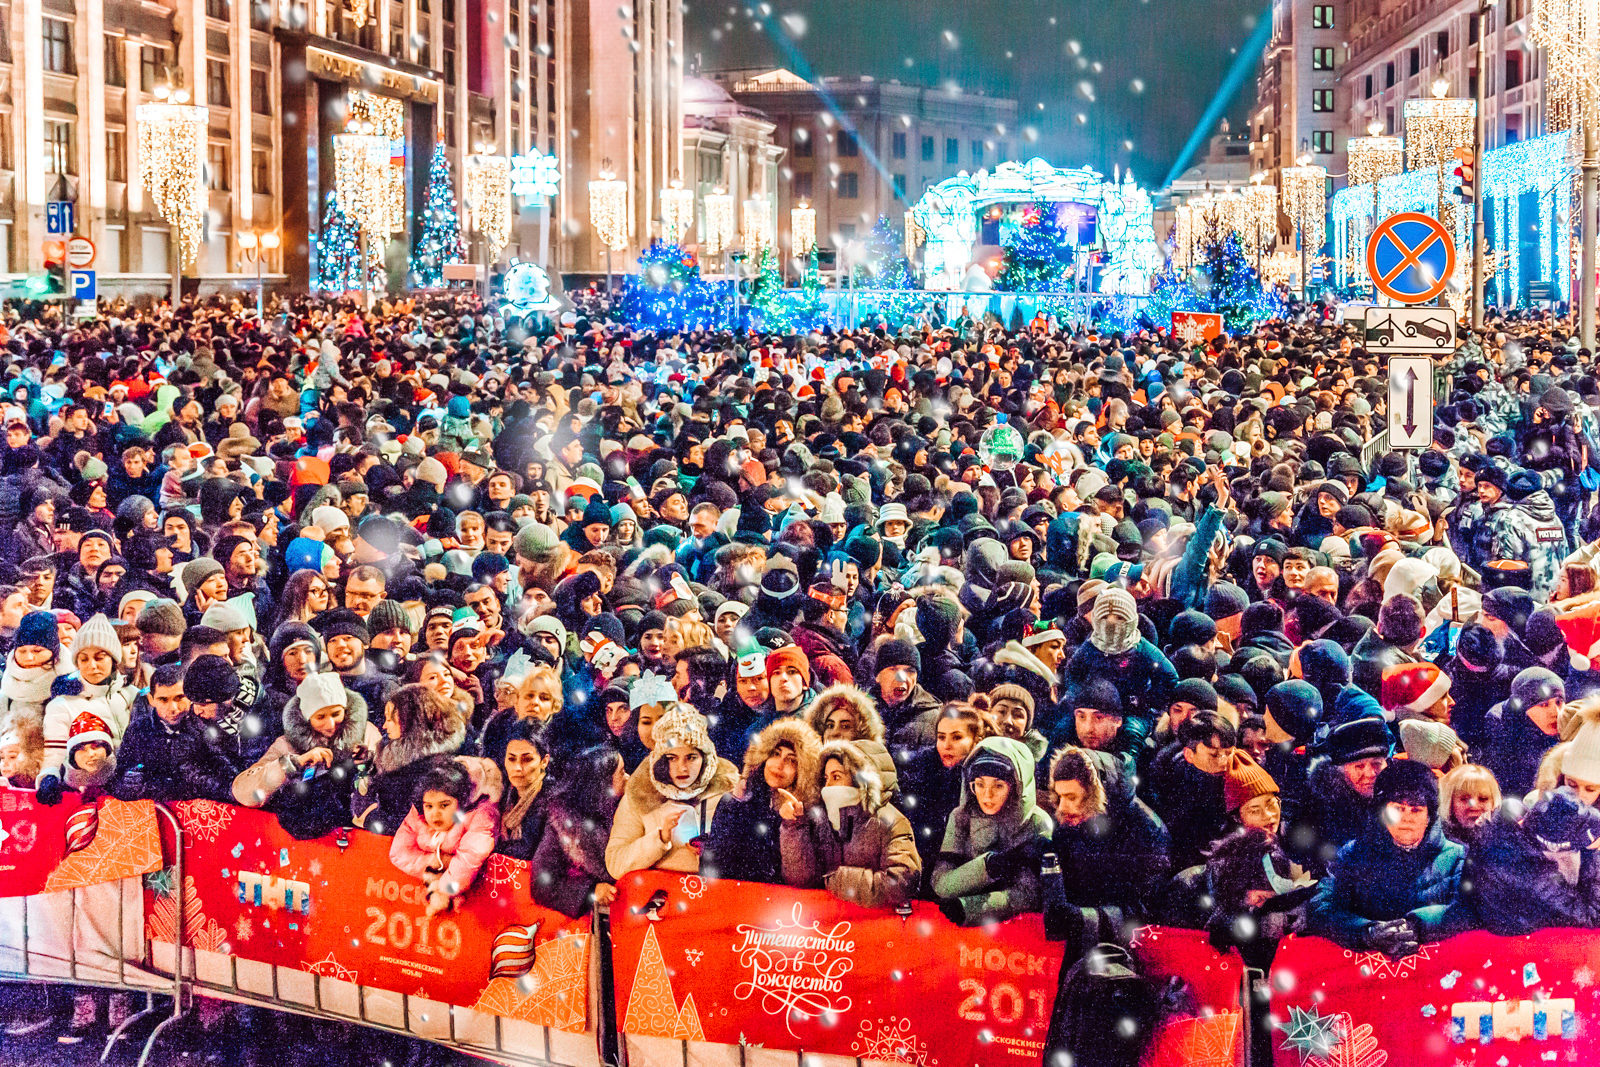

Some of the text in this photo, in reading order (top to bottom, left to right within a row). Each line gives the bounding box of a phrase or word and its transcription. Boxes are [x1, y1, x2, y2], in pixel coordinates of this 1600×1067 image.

[71, 273, 91, 297] P
[238, 870, 310, 916] ТНТ
[364, 906, 461, 961] 2019
[732, 918, 855, 953] Путешествие
[1451, 998, 1575, 1045] ТНТ
[1007, 1047, 1037, 1058] MOS.RU
